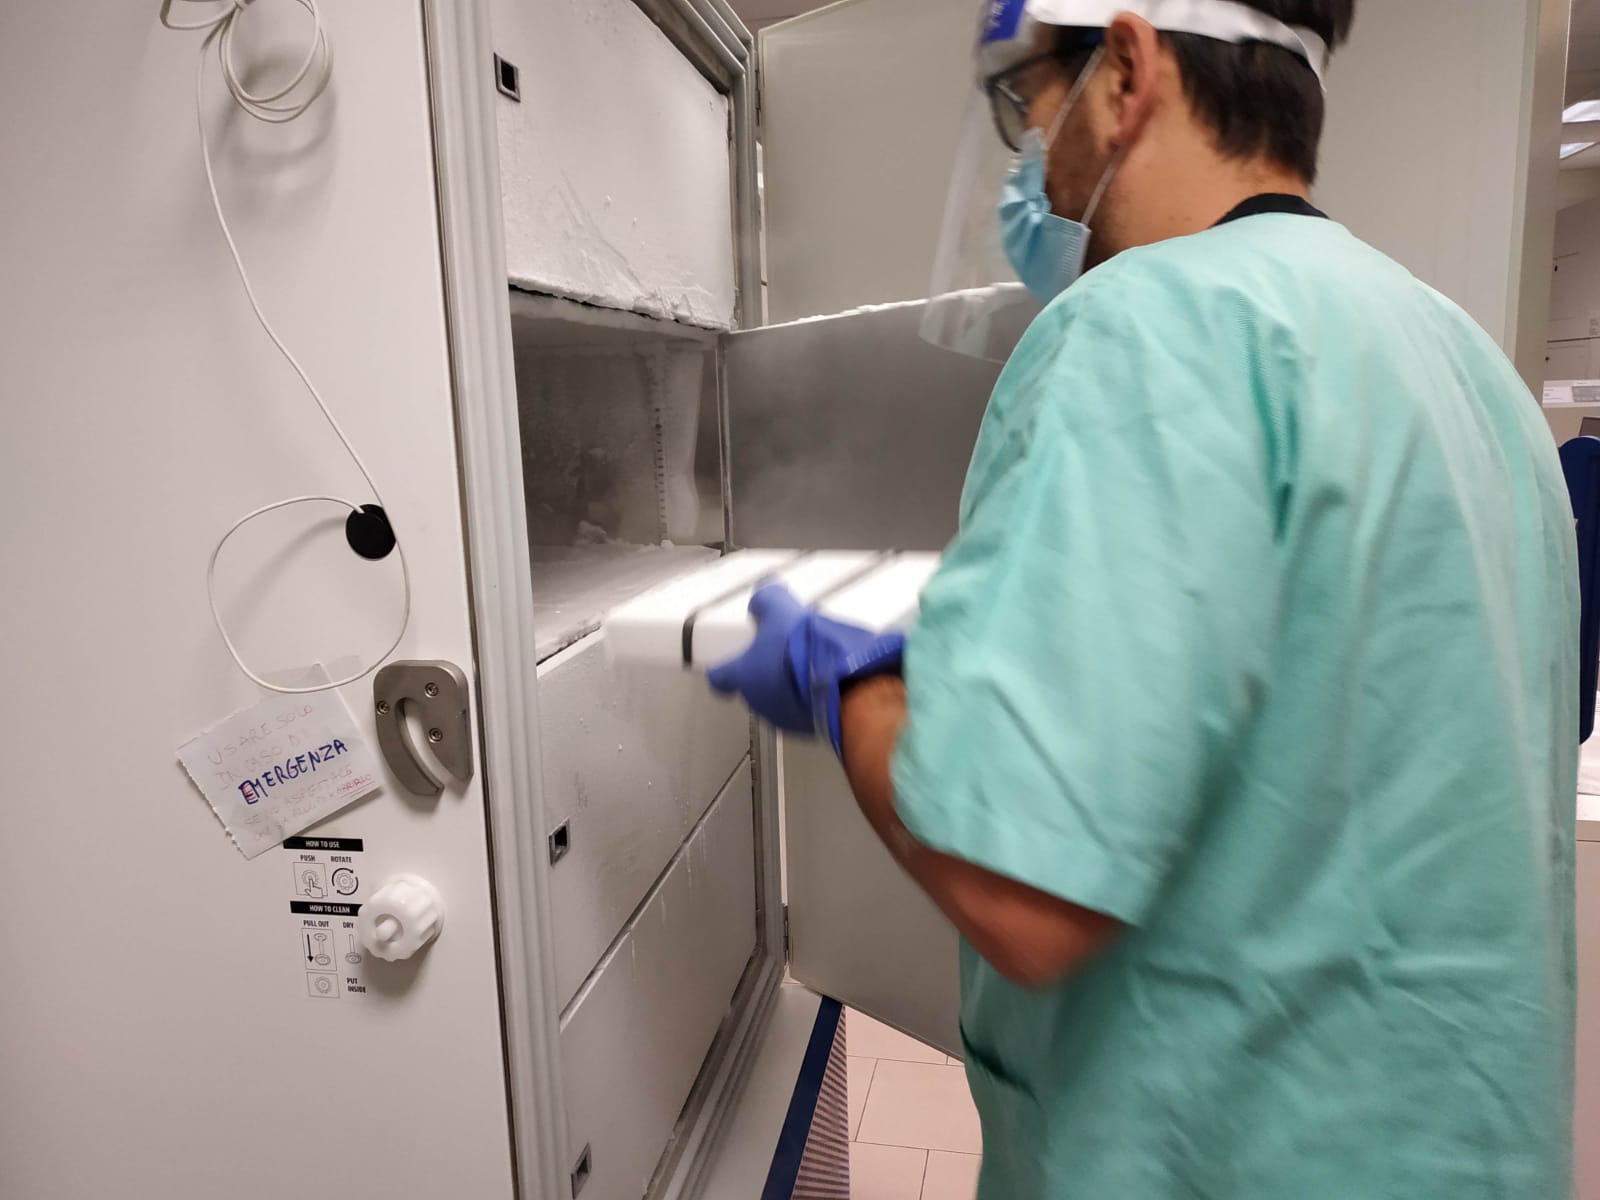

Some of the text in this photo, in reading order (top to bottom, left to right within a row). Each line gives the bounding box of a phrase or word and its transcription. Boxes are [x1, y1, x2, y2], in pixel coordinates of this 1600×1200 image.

[275, 703, 314, 732] SOLO
[237, 738, 349, 805] EMERGENZA
[305, 840, 340, 849] HOW TO USE
[300, 854, 316, 862] PUSH
[330, 855, 353, 863] ROTATE
[309, 904, 323, 912] HOW
[332, 905, 350, 913] CLEAN
[303, 919, 330, 928] PULL OUT
[342, 921, 354, 929] DRY
[346, 977, 358, 985] PUT
[347, 985, 367, 994] INSIDE
